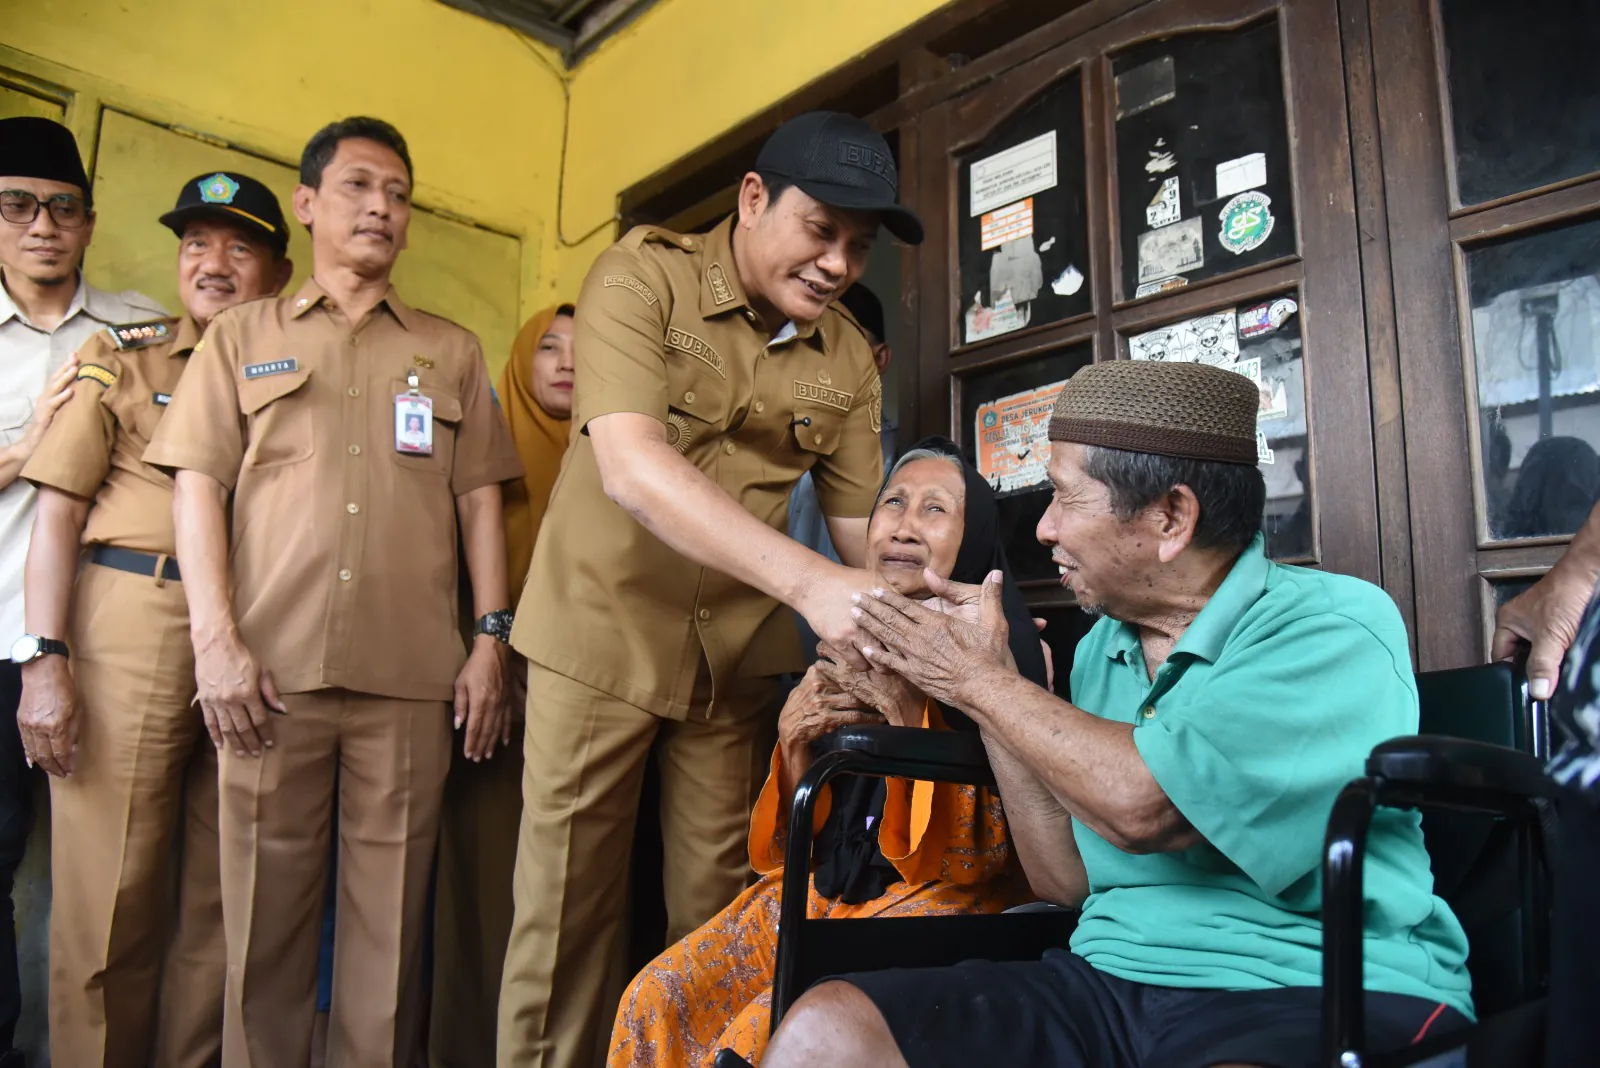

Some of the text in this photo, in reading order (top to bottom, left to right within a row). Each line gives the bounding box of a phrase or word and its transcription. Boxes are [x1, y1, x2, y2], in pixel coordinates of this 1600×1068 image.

[607, 276, 656, 301] KEMENDAGRI
[799, 384, 849, 407] BUPATI
[1002, 412, 1019, 424] DESA
